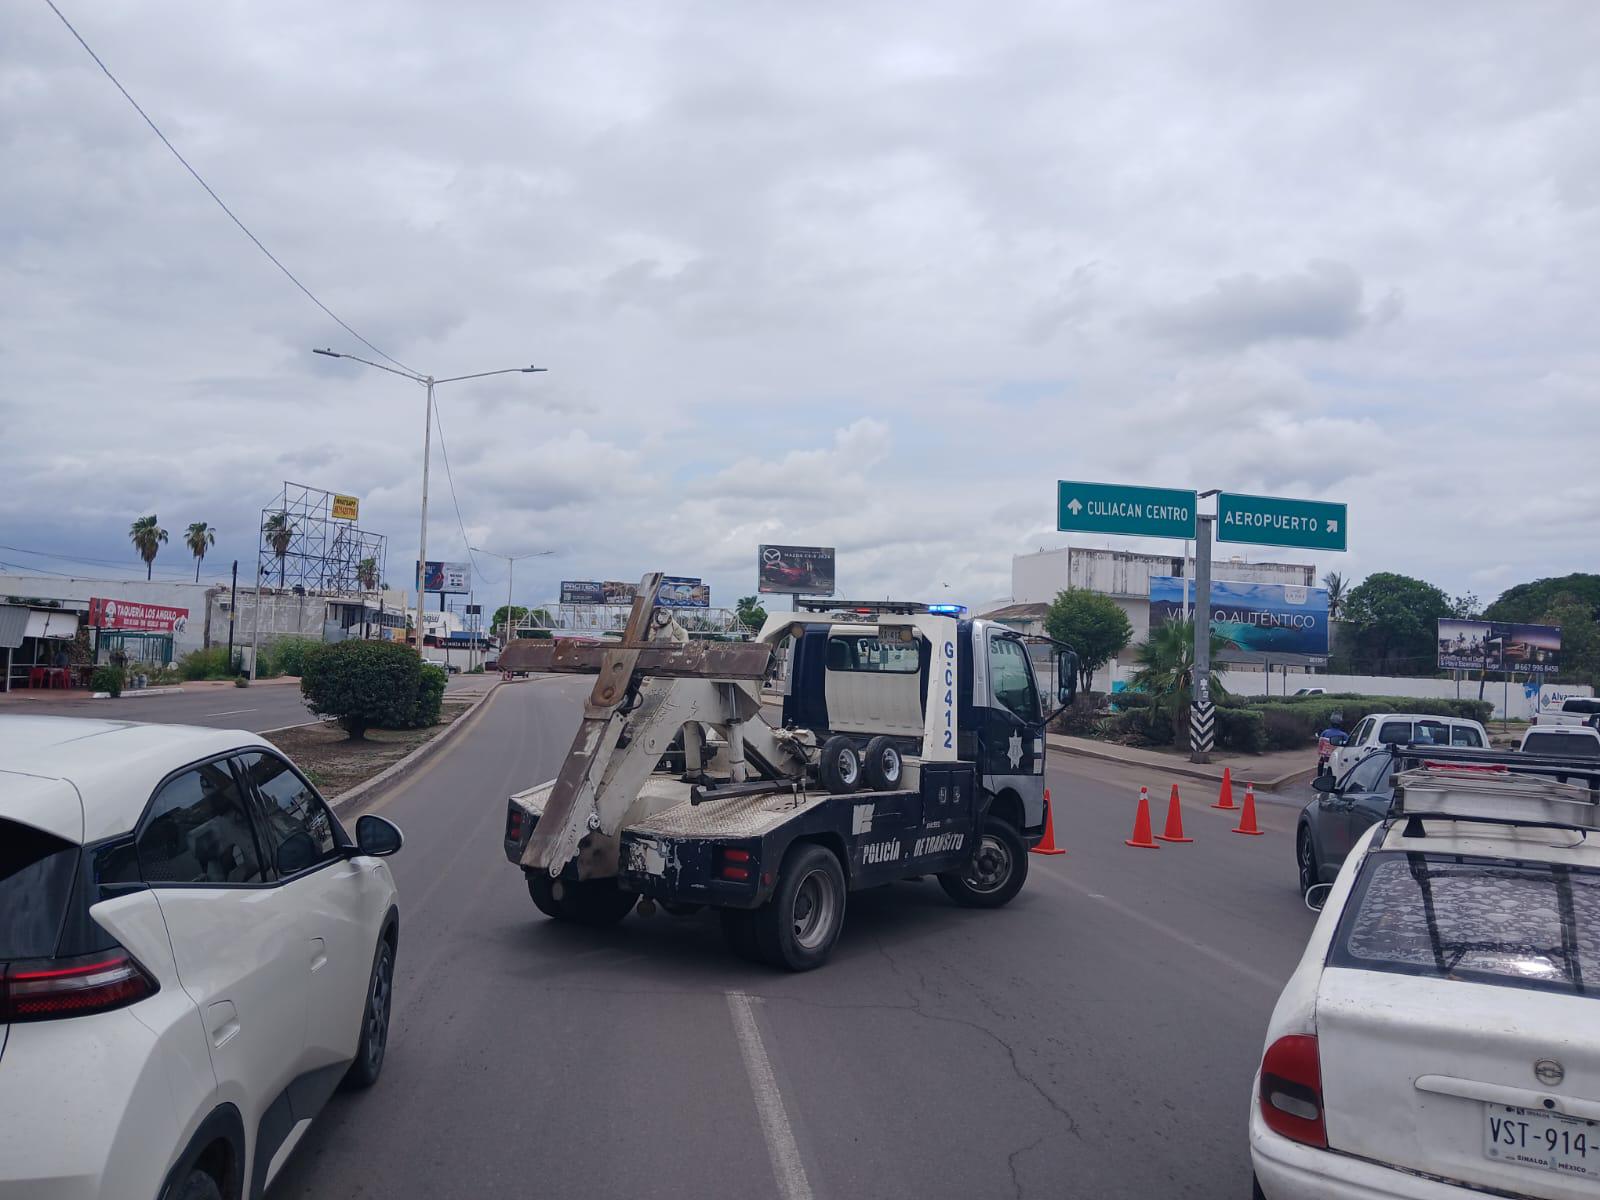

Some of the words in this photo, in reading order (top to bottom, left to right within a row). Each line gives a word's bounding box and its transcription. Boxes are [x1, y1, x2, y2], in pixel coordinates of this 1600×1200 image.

[1087, 501, 1142, 518] CULIACAN
[1146, 505, 1188, 521] CENTRO
[1224, 511, 1318, 532] AEROPUERTO
[144, 607, 156, 619] LOS
[1167, 607, 1196, 623] VIV
[1231, 610, 1315, 628] AUTÉNTICO
[863, 837, 900, 864] POLICÍA
